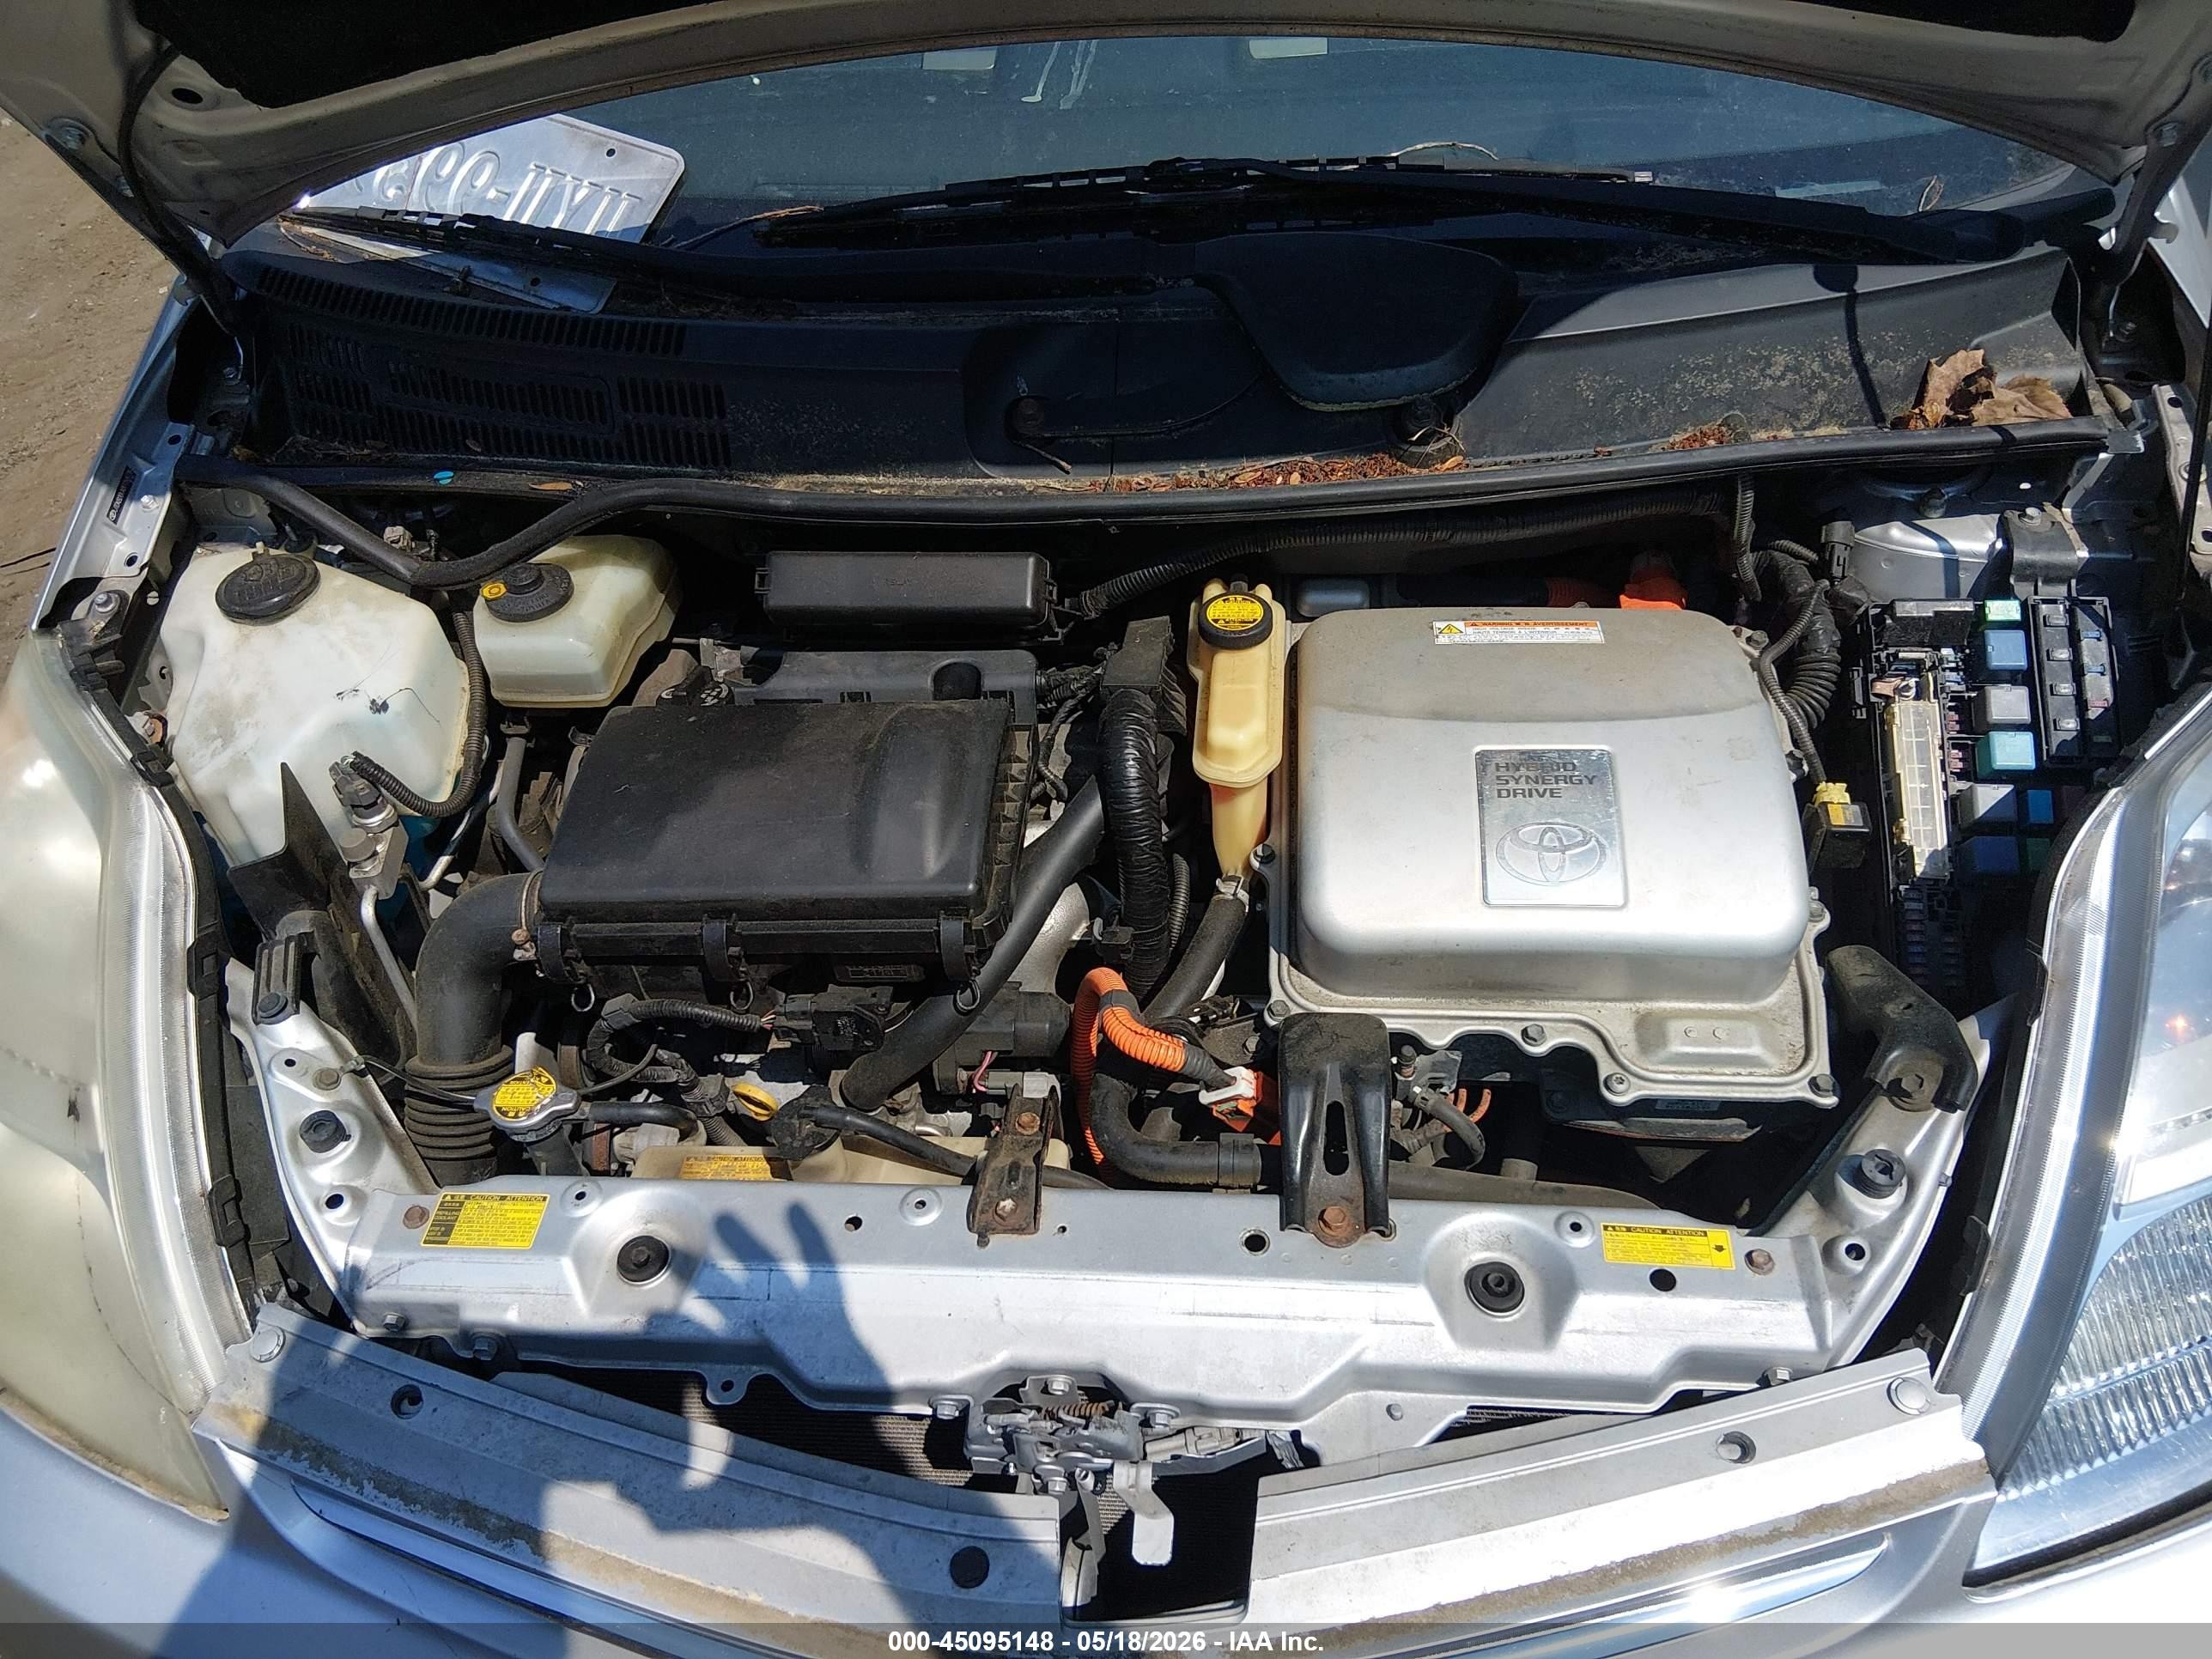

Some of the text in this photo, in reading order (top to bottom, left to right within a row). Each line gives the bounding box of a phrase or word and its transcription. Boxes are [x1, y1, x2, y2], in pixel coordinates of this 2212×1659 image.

[1495, 762, 1577, 773] HYBRID
[1496, 775, 1597, 787] SYNERGY
[1497, 787, 1563, 799] DRIVE
